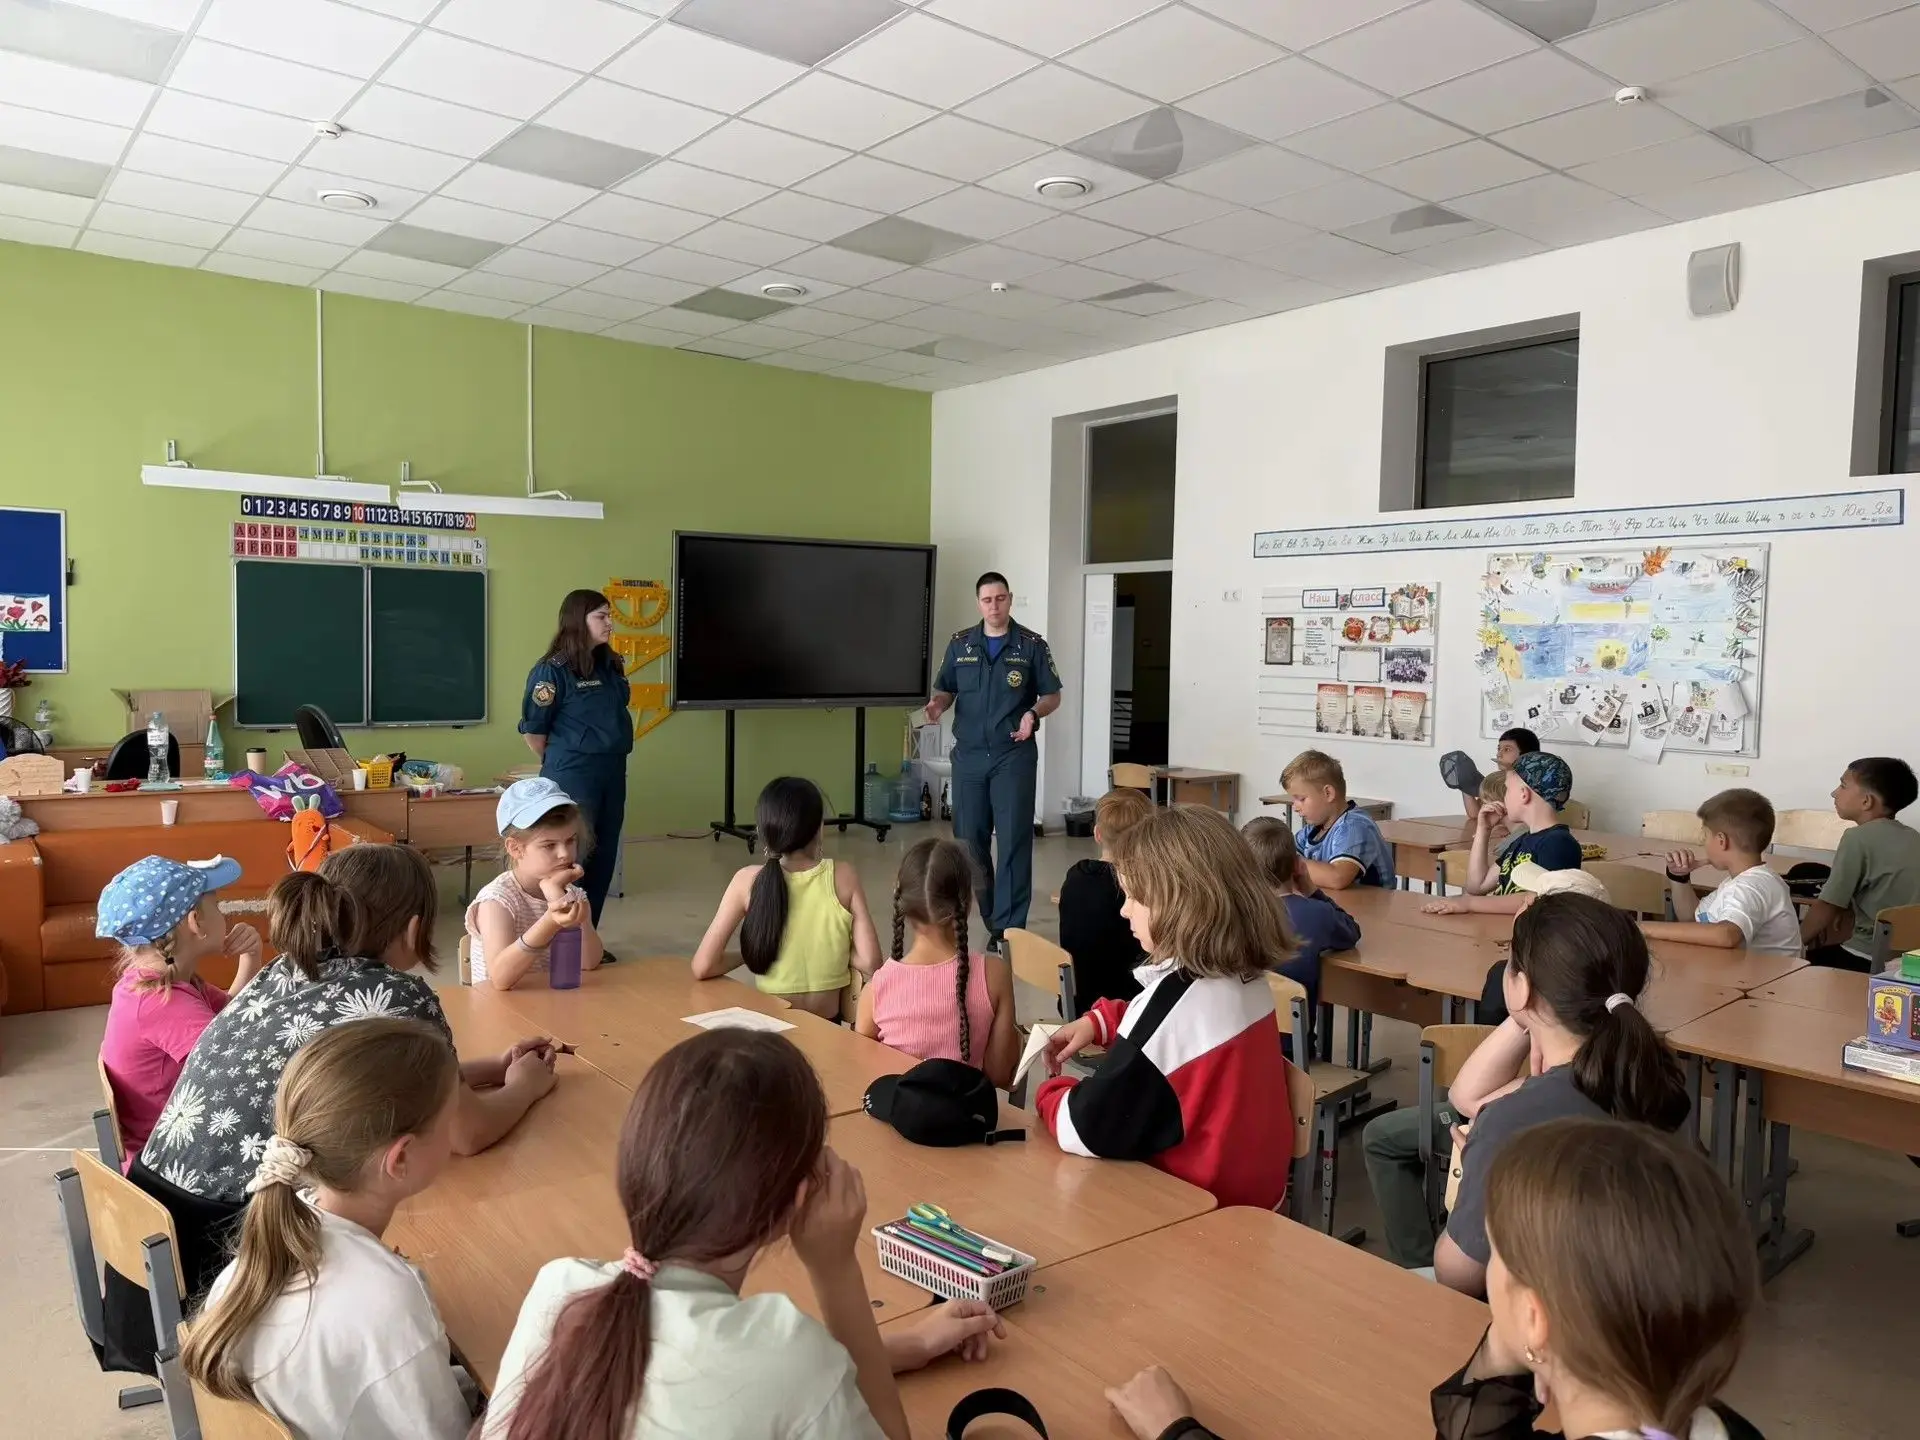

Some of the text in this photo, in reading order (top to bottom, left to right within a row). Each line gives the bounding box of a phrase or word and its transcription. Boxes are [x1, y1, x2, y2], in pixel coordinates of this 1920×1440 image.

[242, 498, 475, 528] 0 1 2 3 4 5 6 7 8 9 10 11 12 13 14 15 16 17 18 19 20
[1309, 591, 1382, 603] Наш класс
